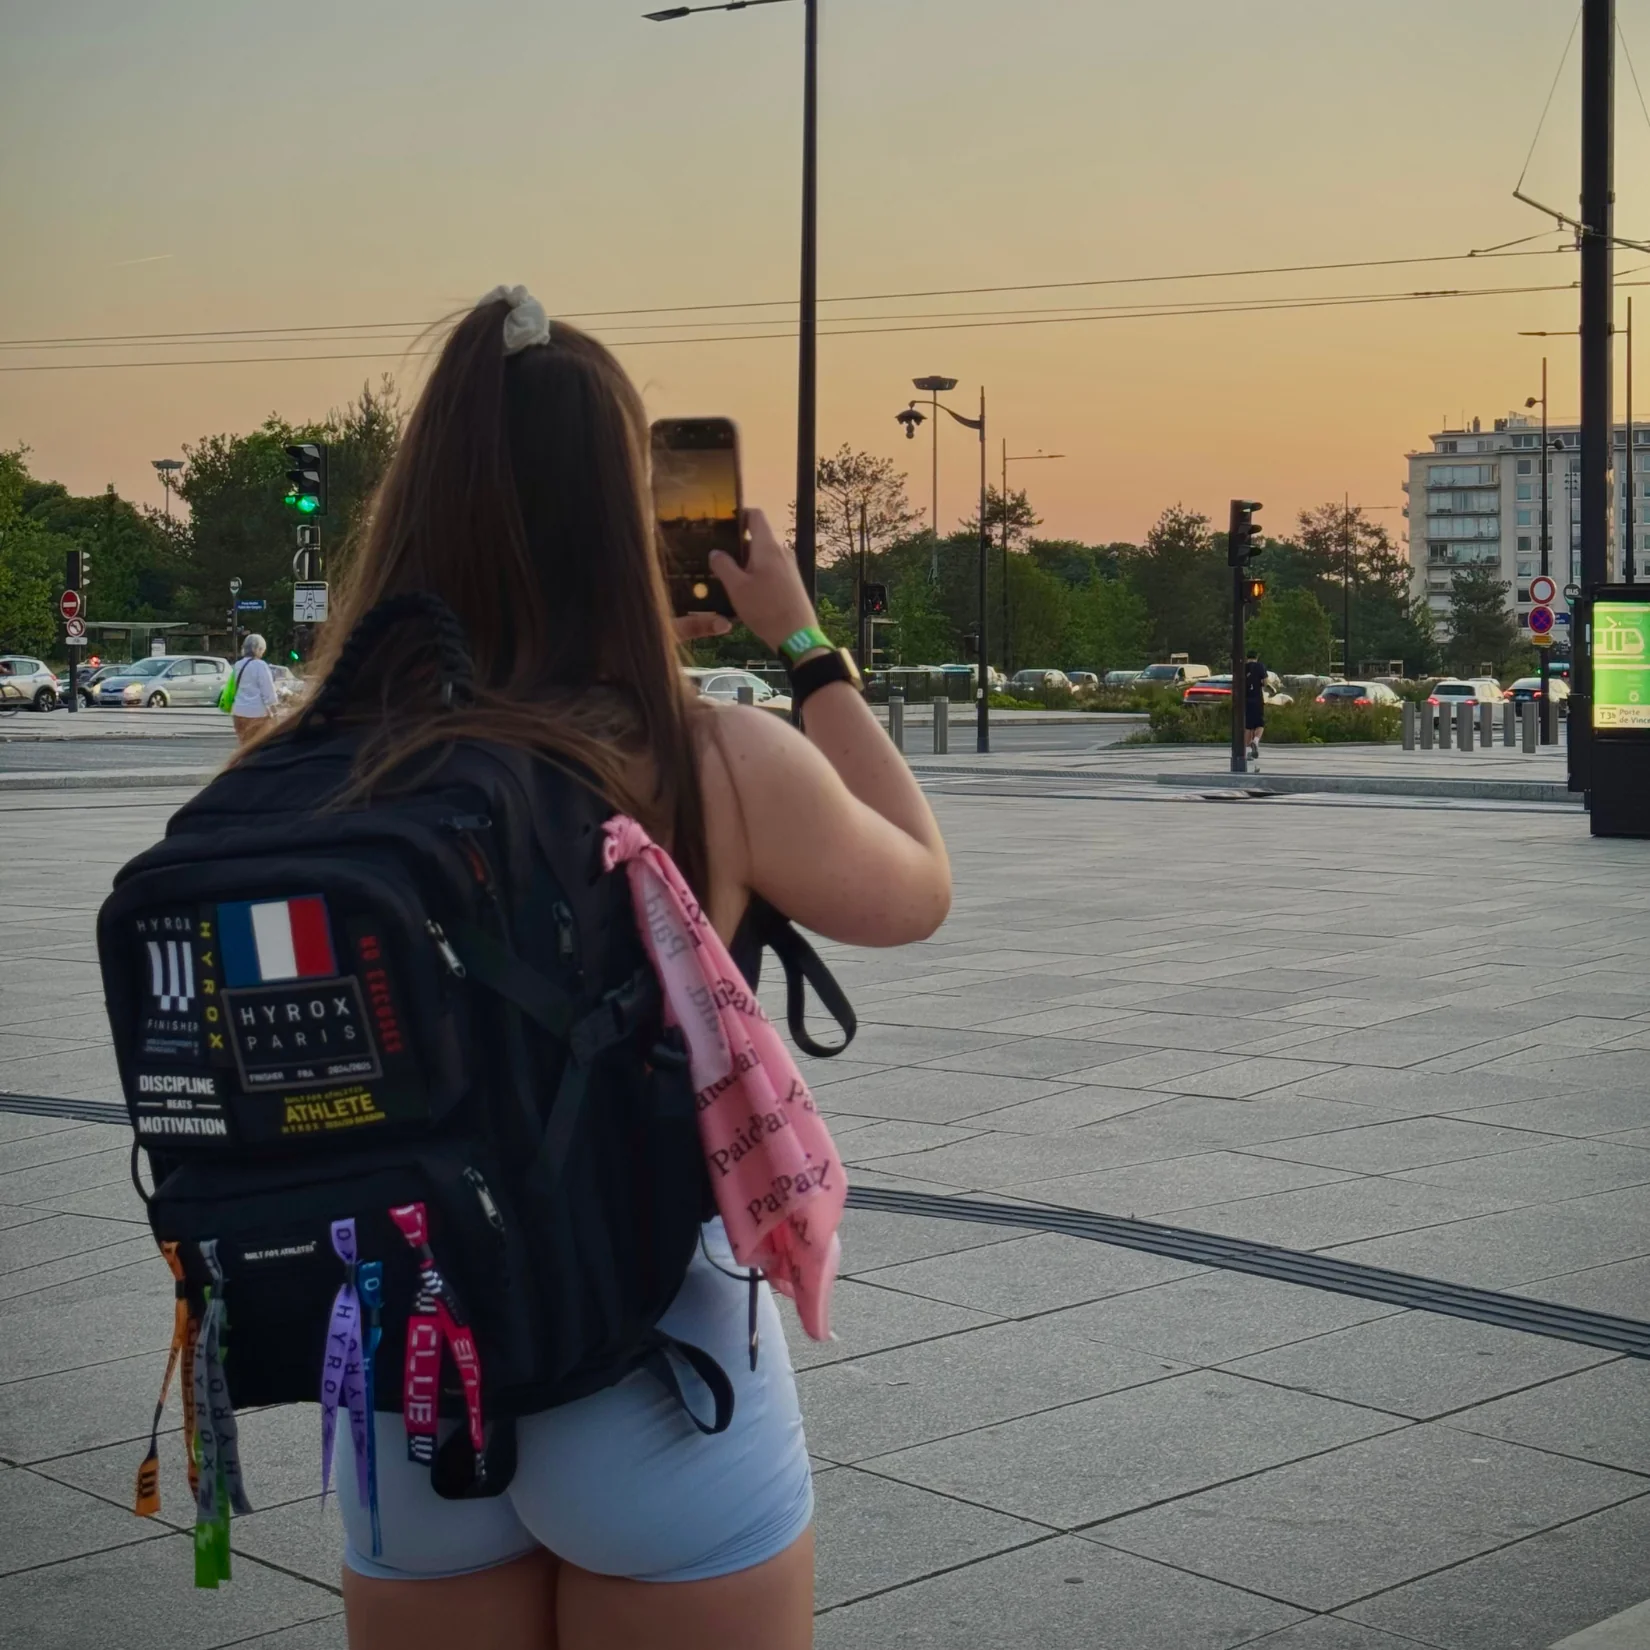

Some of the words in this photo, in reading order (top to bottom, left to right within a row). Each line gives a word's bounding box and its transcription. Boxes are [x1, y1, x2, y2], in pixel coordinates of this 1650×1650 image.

[1565, 588, 1579, 596] BUS
[1619, 708, 1640, 716] Porte
[1619, 716, 1629, 724] de
[136, 917, 191, 932] HYROX
[200, 920, 225, 1050] HYROX
[241, 997, 350, 1026] HYROX
[147, 1018, 199, 1032] FINISHER
[248, 1025, 356, 1050] PARIS
[139, 1075, 216, 1096] DISCIPLINE
[248, 1071, 285, 1083] FINISHER
[166, 1099, 193, 1110] BEATS
[286, 1093, 376, 1123] ATHLETE
[138, 1116, 228, 1136] MOTIVATION
[324, 1304, 354, 1418] HYROX
